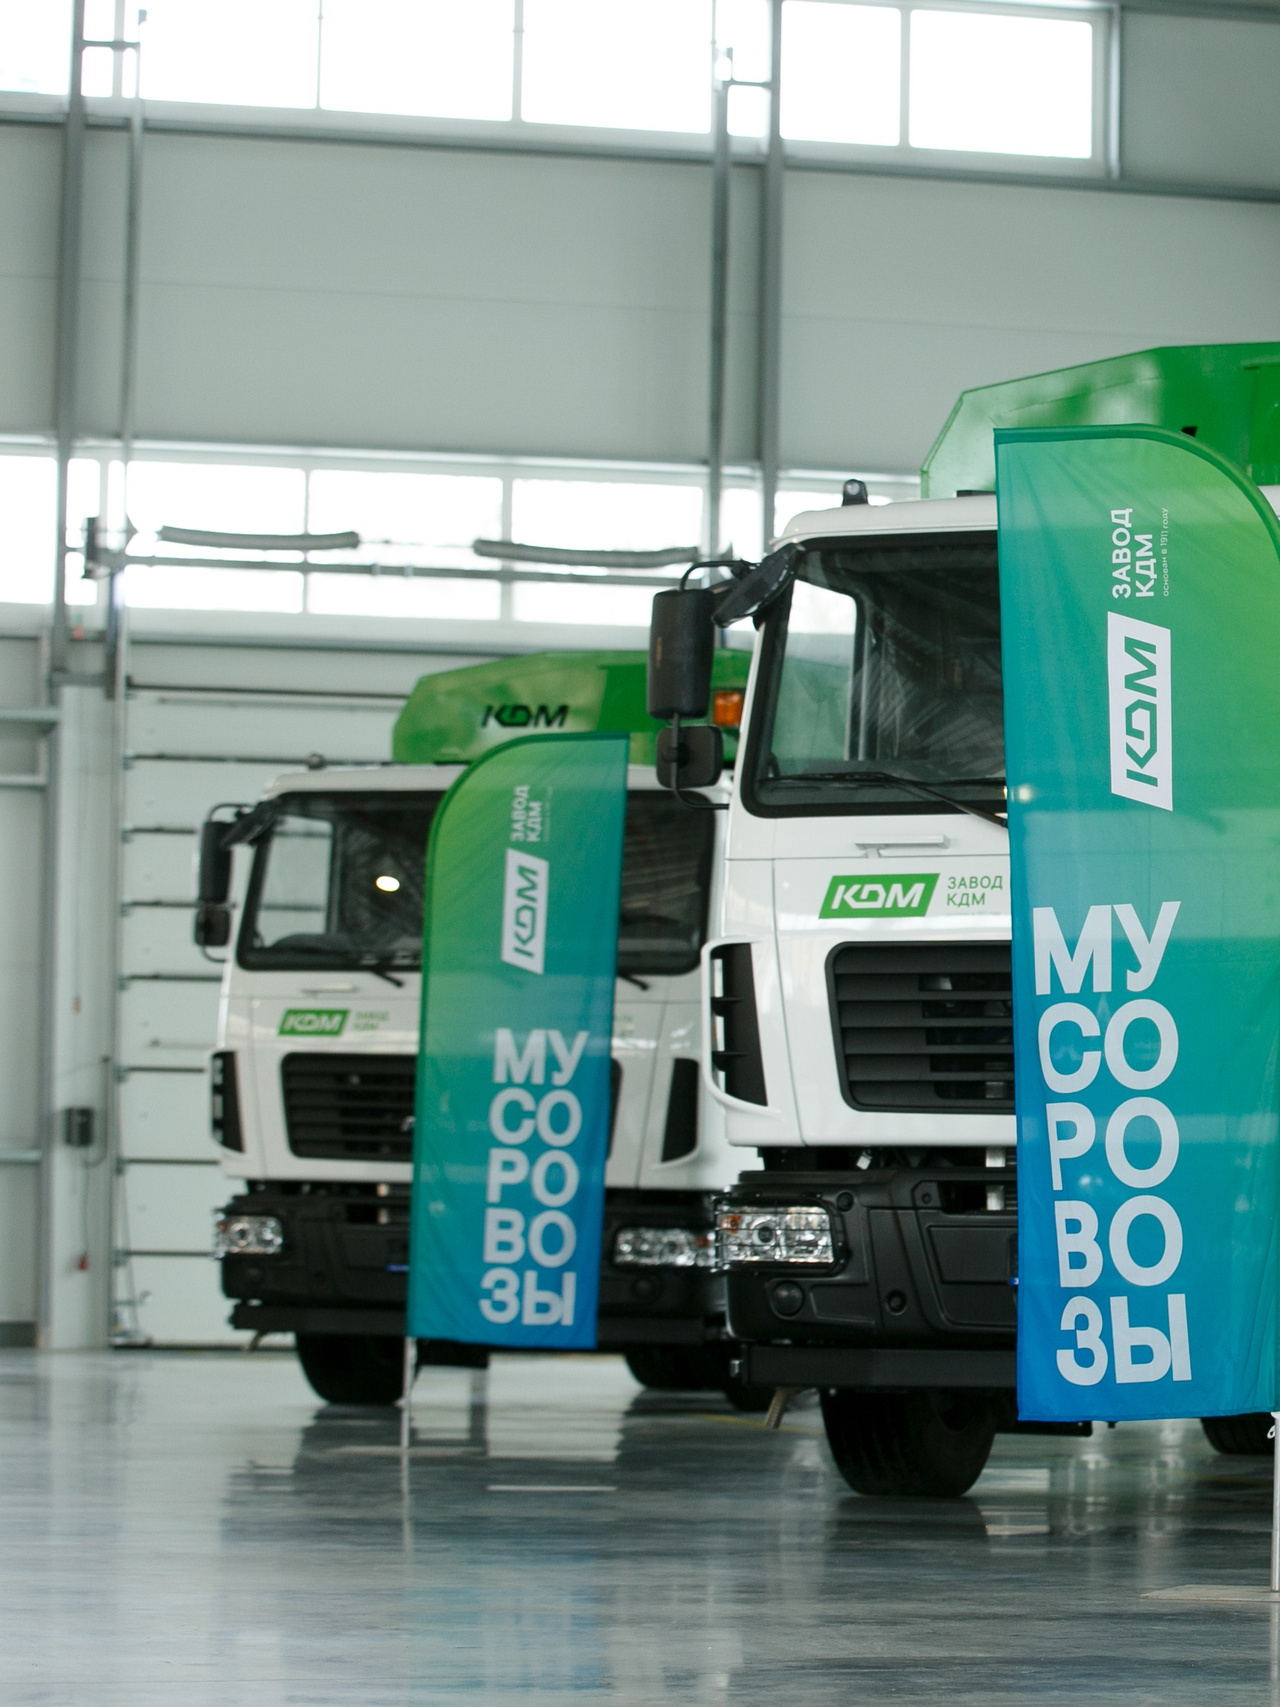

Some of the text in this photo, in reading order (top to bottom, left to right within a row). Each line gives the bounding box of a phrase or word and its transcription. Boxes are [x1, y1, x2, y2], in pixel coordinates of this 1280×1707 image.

[1160, 530, 1169, 546] 1911
[1161, 507, 1169, 529] году
[1110, 508, 1134, 599] ЗАВОД
[1134, 533, 1157, 597] КДМ
[1161, 556, 1170, 597] основан
[481, 704, 569, 728] KDM
[1124, 635, 1159, 788] KDM
[510, 784, 530, 842] ЗАВОД
[526, 801, 543, 843] КДМ
[514, 865, 540, 959] KDM
[831, 883, 926, 910] KDM
[947, 875, 1003, 891] ЗАВОД
[947, 892, 986, 907] КДМ
[1032, 901, 1181, 995] МУ
[283, 1013, 343, 1032] KDM
[1037, 998, 1179, 1094] СО
[493, 1028, 590, 1086] МУ
[488, 1087, 583, 1147] СО
[1045, 1096, 1180, 1191] РО
[485, 1148, 580, 1208] РО
[483, 1207, 577, 1268] ВО
[1054, 1194, 1184, 1288] ВО
[479, 1267, 577, 1326] ЗЫ
[1056, 1293, 1193, 1386] ЗЫ
